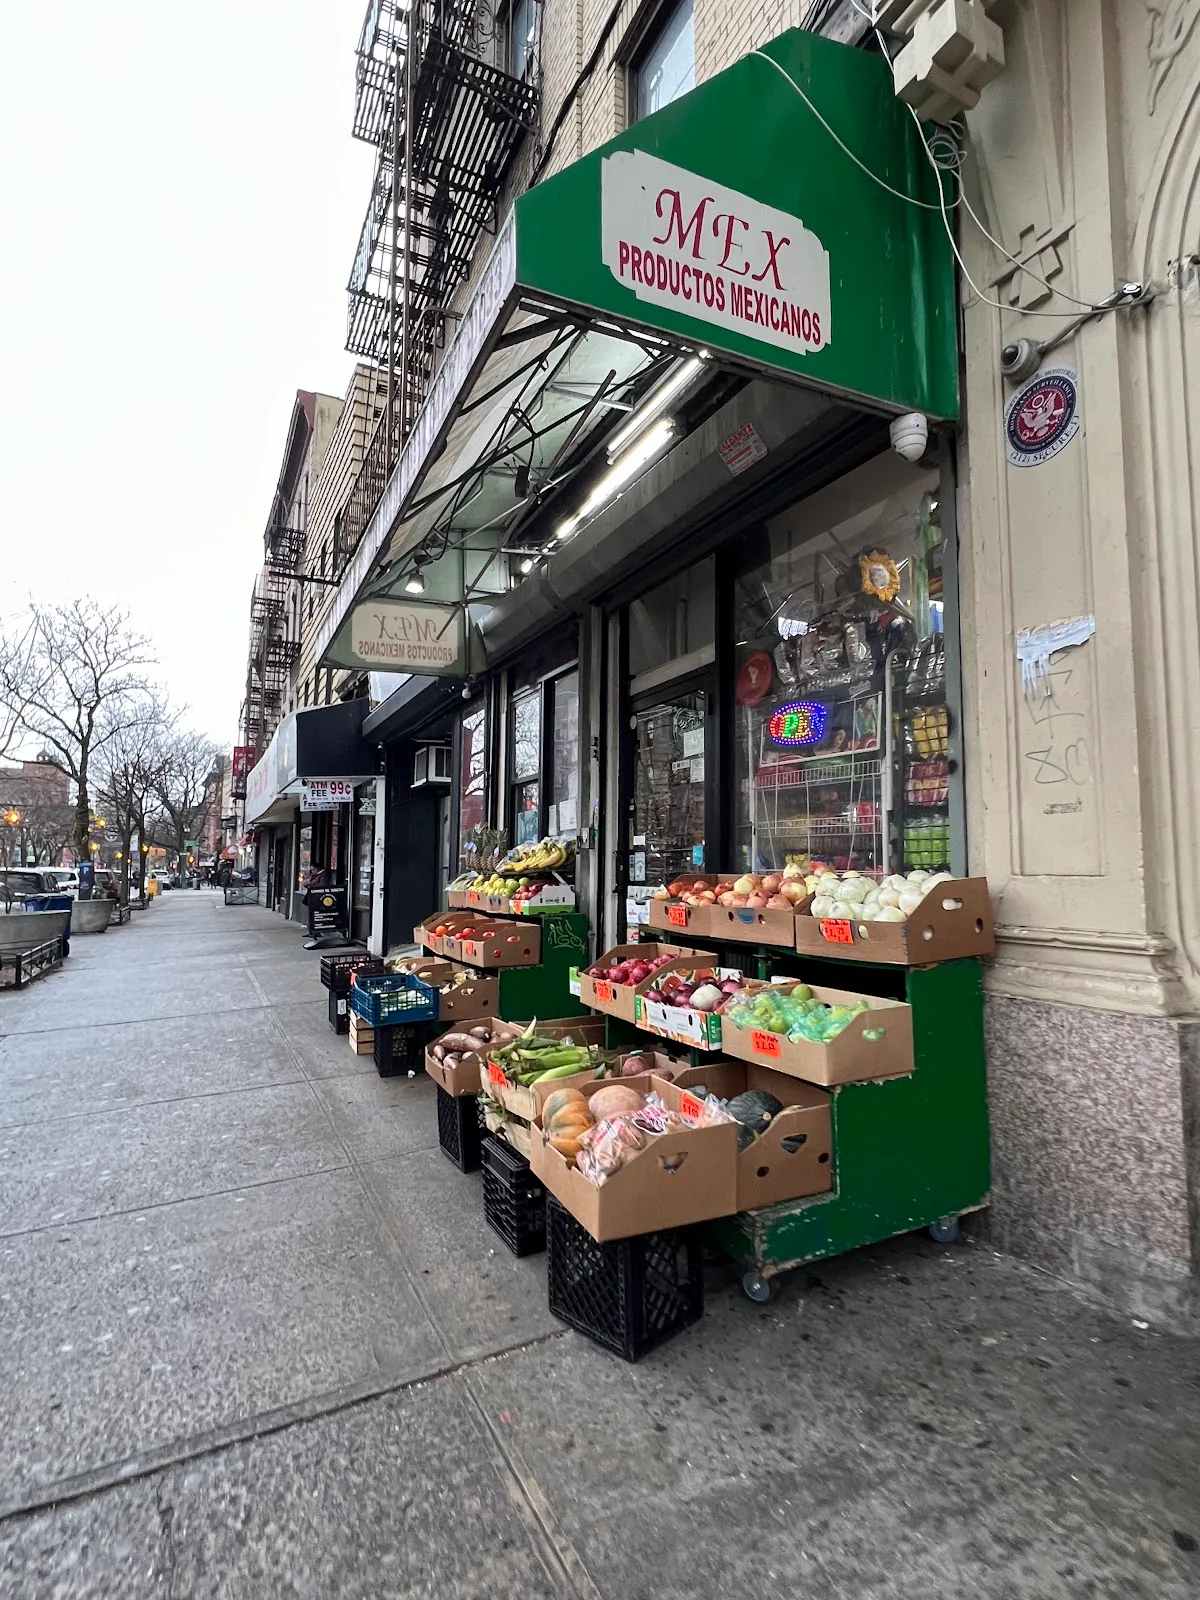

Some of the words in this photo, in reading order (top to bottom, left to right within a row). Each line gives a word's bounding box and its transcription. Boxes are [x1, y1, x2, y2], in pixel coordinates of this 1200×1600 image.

[653, 188, 791, 291] MEX
[619, 240, 725, 312] PRODUCTOS
[731, 281, 821, 346] MEXICANOS
[311, 789, 327, 797] FEE
